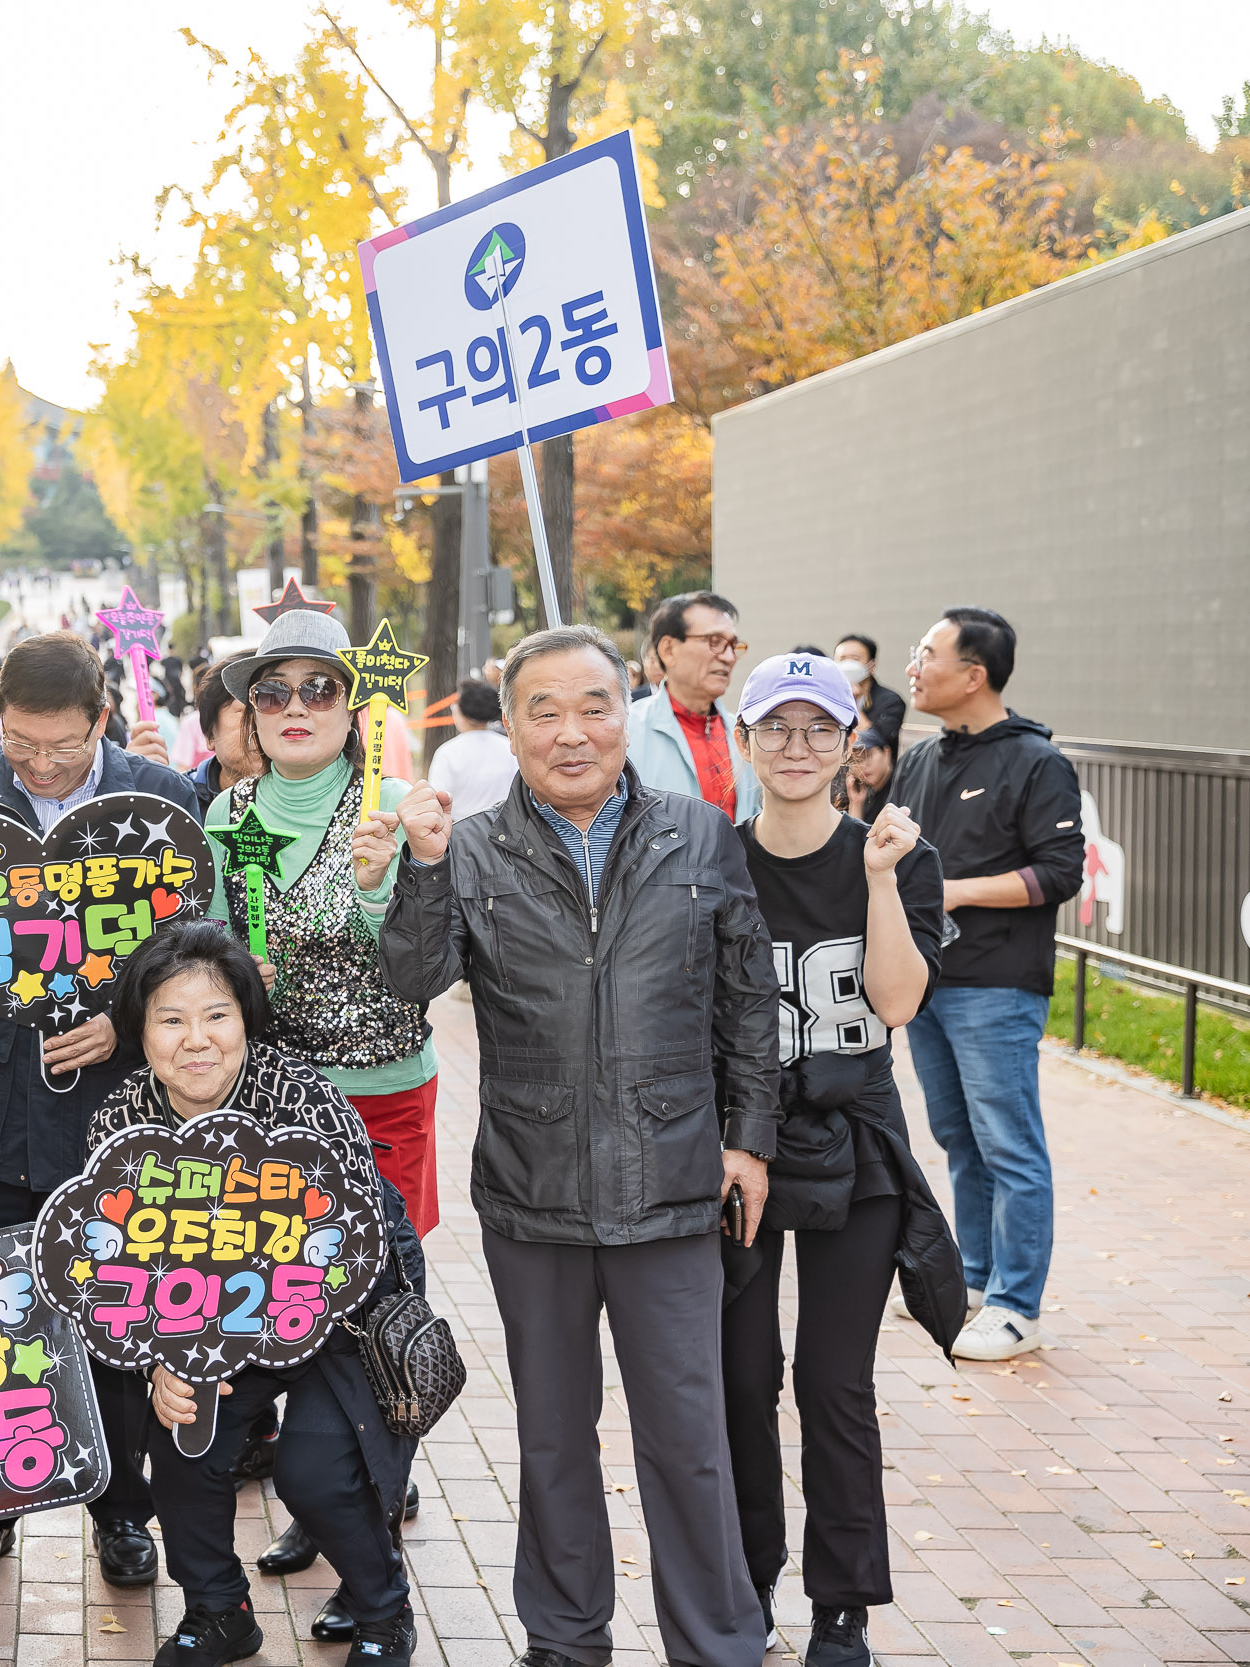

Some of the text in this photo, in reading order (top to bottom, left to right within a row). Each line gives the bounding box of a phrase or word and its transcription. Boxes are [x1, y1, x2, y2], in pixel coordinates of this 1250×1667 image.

[415, 290, 618, 430] 구의2동
[355, 651, 411, 671] 폼미쳤다
[786, 660, 813, 678] M
[361, 672, 403, 691] 김기덕
[372, 731, 383, 765] 사랑해
[232, 832, 274, 846] 빛이나는
[237, 844, 270, 855] 구의2동
[237, 854, 271, 866] 화이팅
[138, 1154, 306, 1205] 슈퍼스타
[126, 1207, 308, 1263] 우주최강
[94, 1264, 326, 1341] 구의2동
